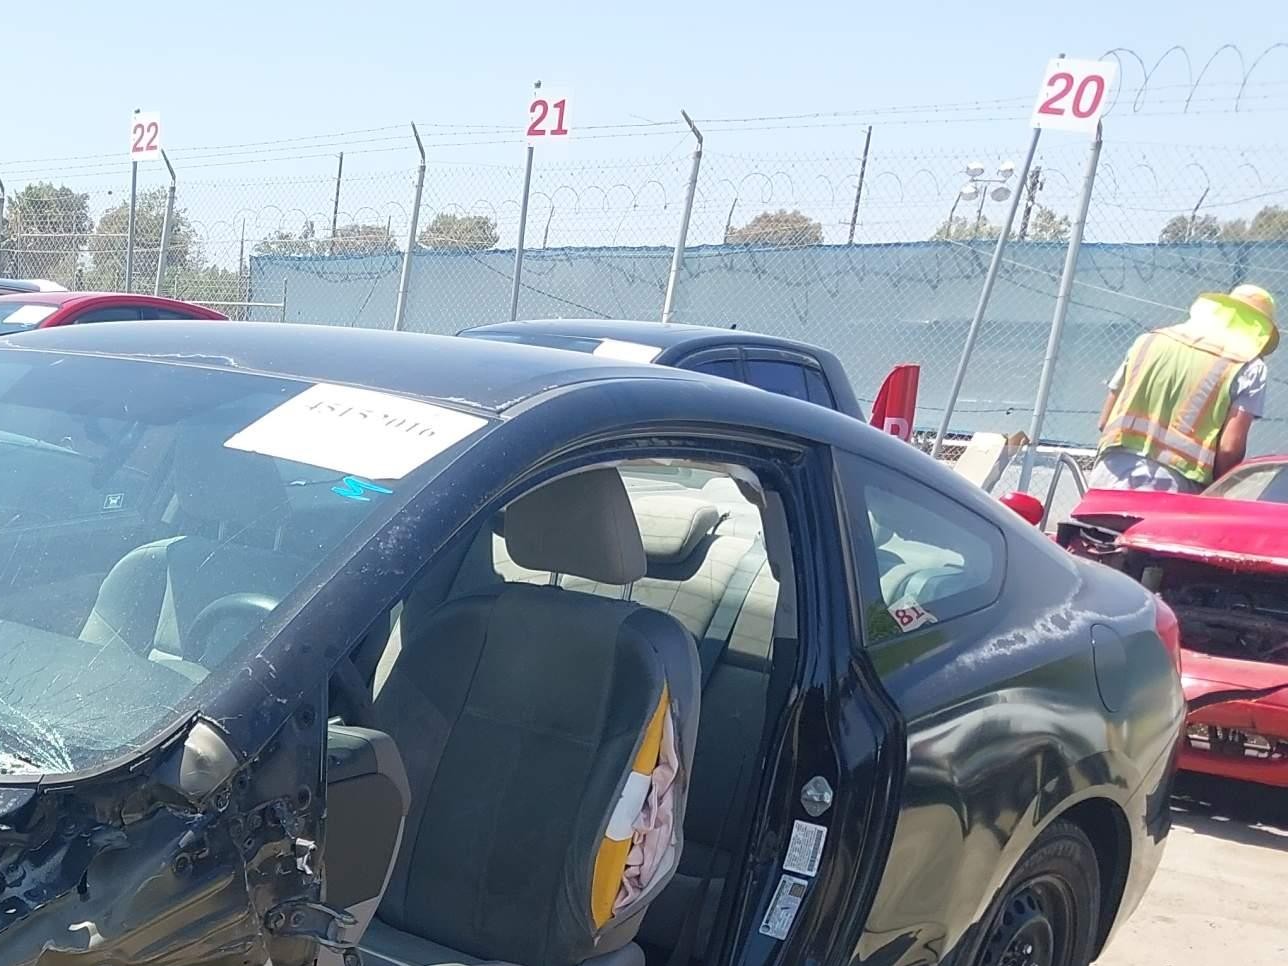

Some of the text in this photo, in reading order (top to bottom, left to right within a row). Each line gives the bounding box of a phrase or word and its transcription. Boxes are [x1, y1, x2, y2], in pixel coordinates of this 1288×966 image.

[1037, 71, 1106, 119] 20
[526, 98, 569, 137] 21
[132, 122, 159, 153] 22
[305, 401, 437, 436] 4515016
